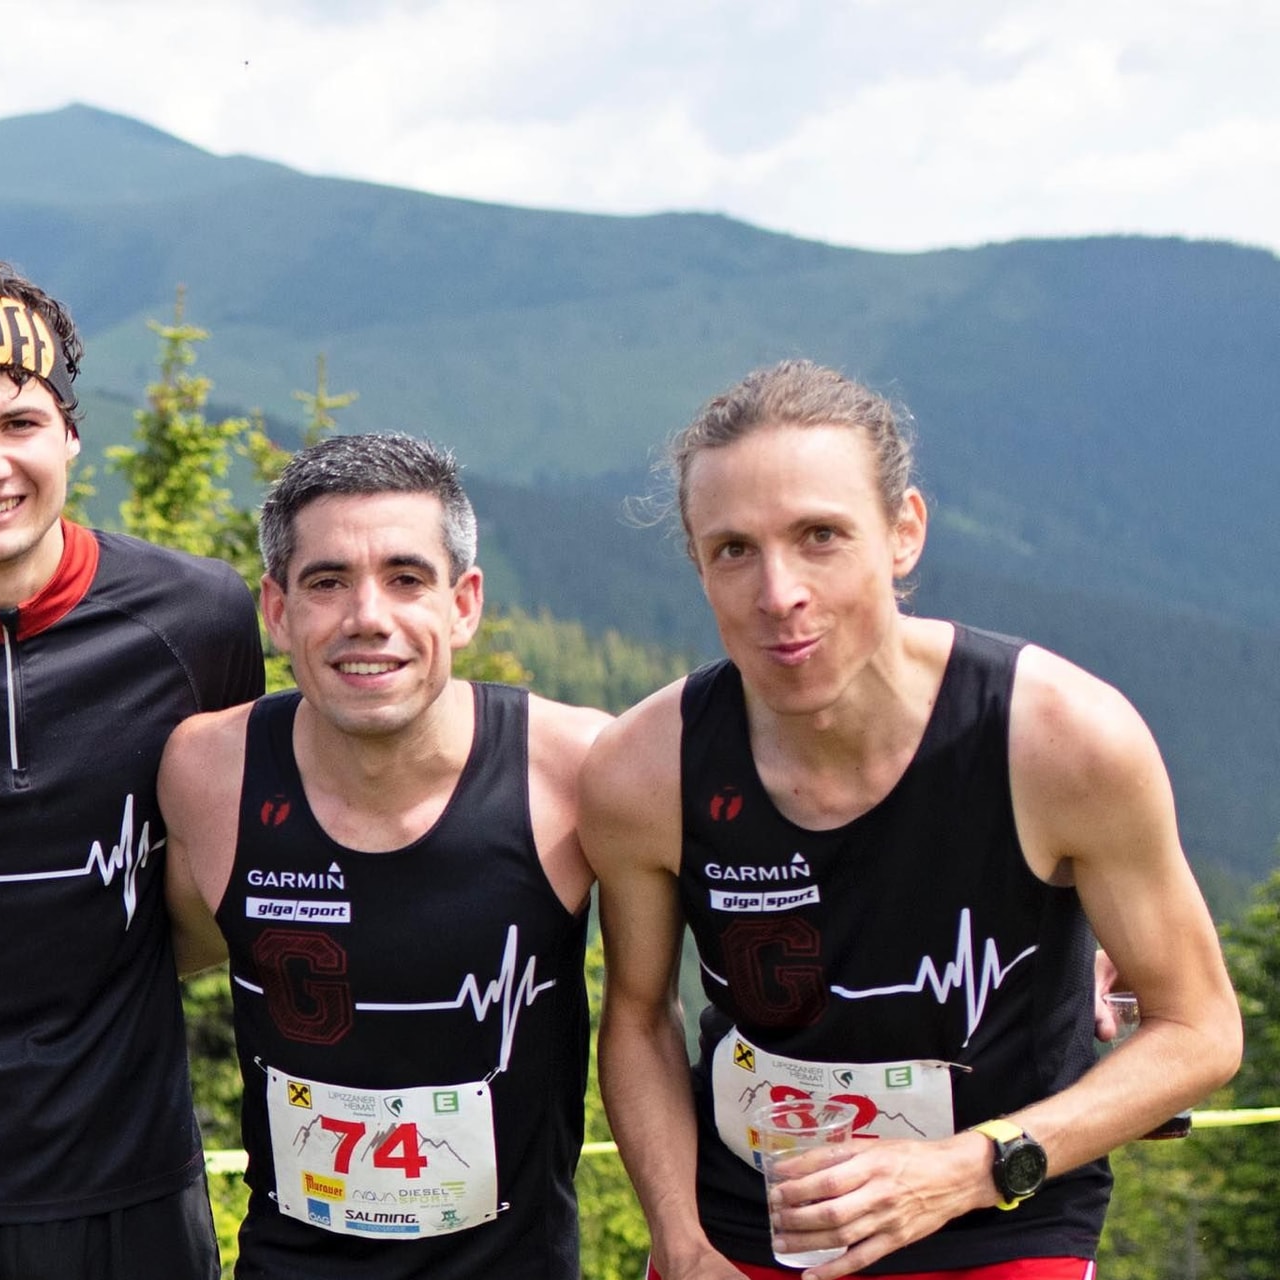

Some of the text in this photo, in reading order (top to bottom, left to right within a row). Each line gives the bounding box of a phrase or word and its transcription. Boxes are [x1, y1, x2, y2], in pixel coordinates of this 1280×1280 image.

[247, 870, 344, 889] GARMIN
[705, 863, 810, 881] GARMIN
[320, 1116, 427, 1178] 74
[399, 1188, 449, 1196] DIESEL
